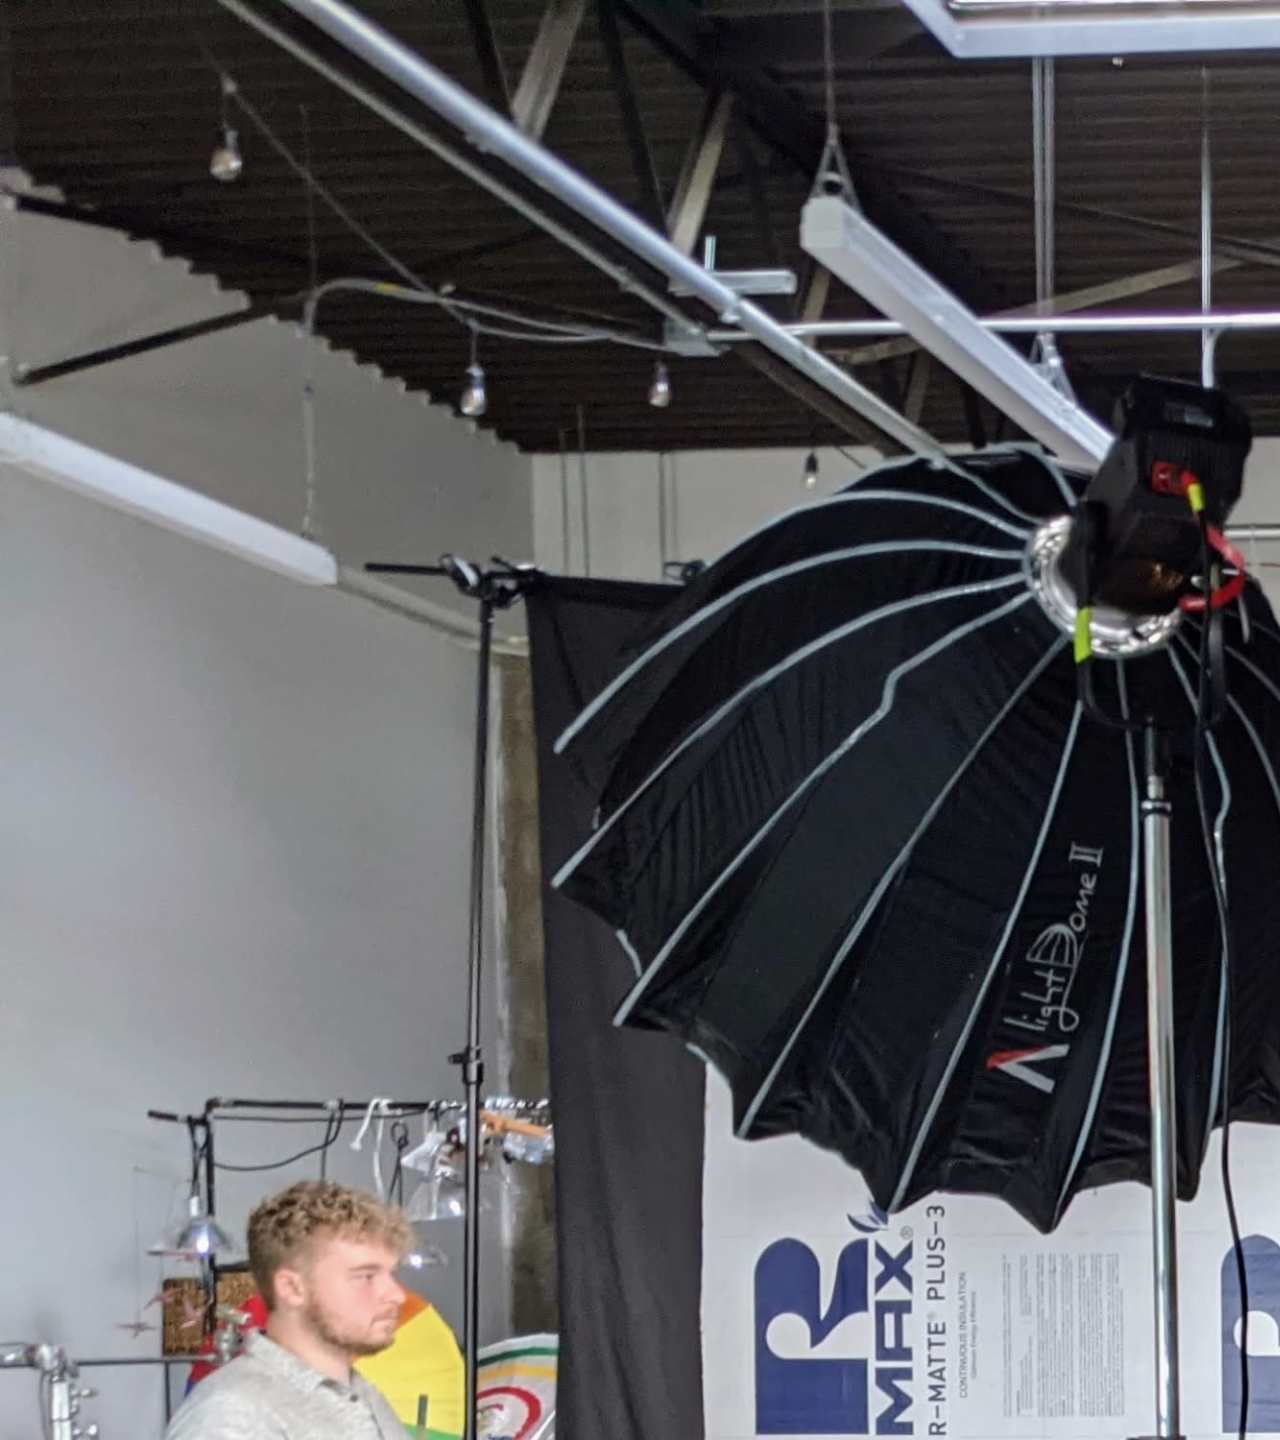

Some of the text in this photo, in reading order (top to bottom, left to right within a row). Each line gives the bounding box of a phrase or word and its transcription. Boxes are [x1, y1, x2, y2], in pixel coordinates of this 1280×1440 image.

[875, 1239, 914, 1436] MAX
[925, 1204, 947, 1437] R-MATTE PLUS-3
[958, 1333, 968, 1399] CONTINUOUS
